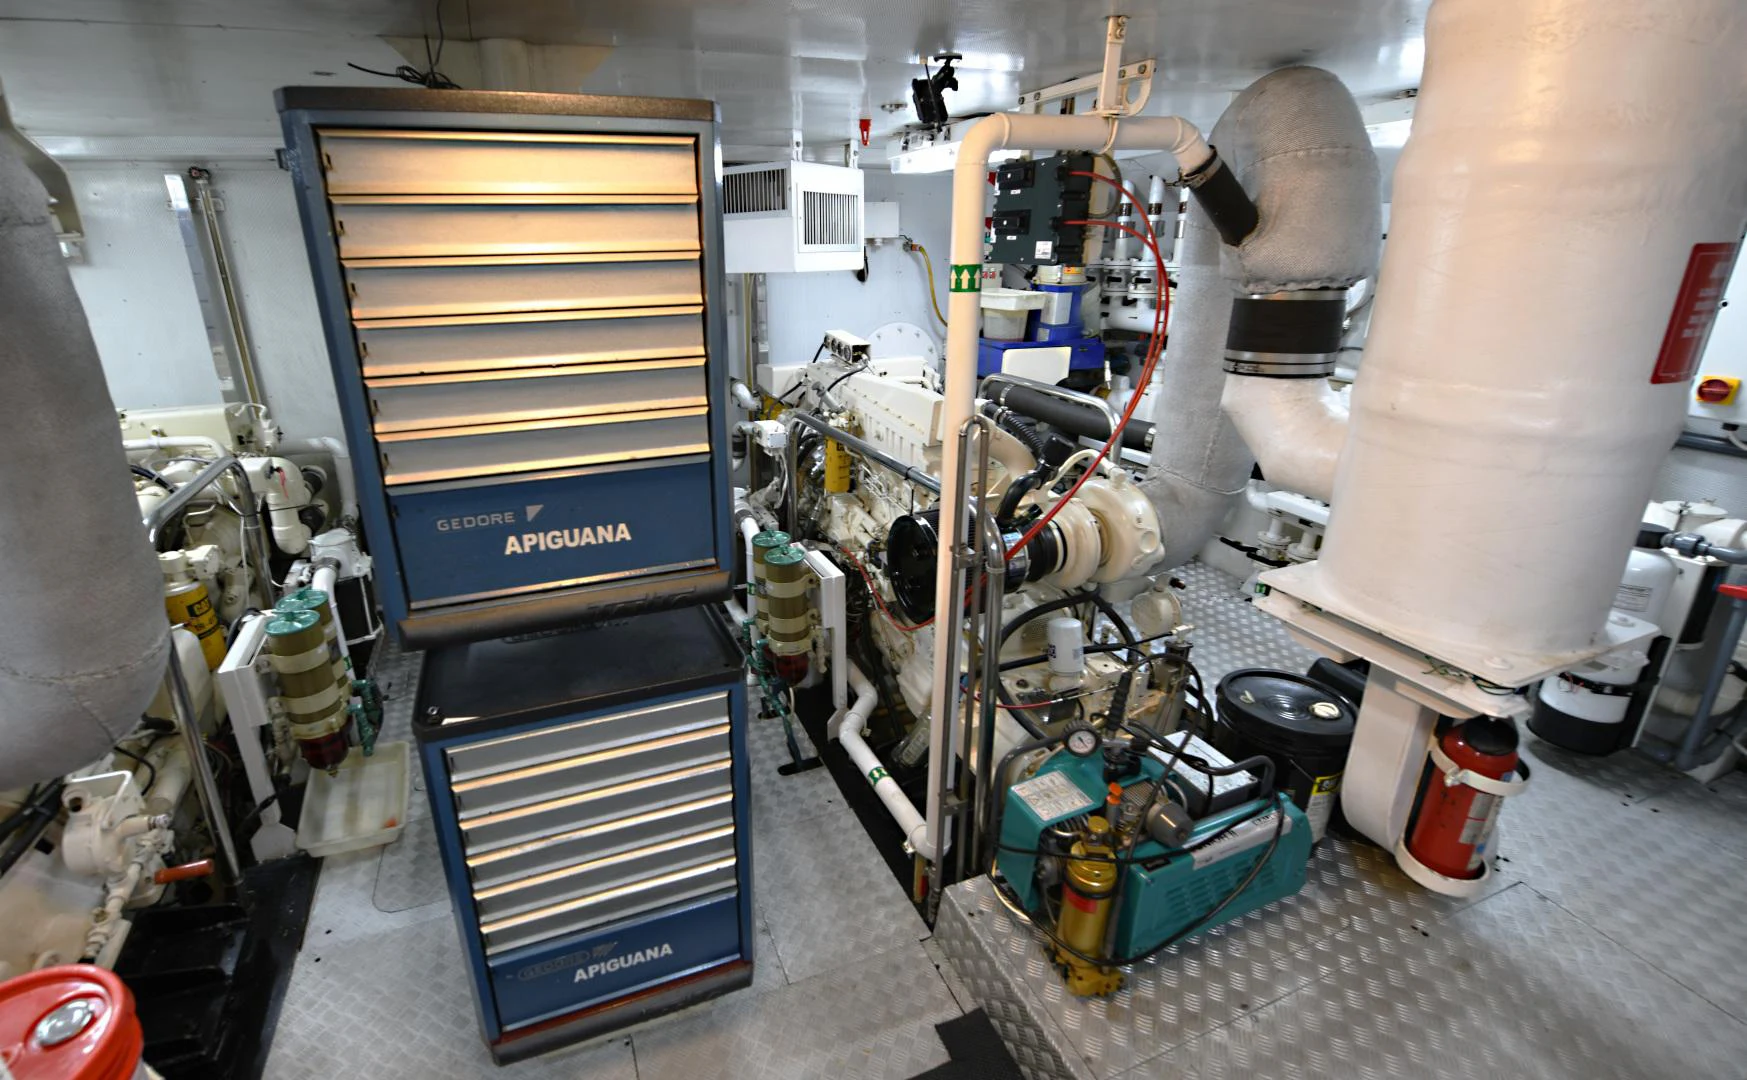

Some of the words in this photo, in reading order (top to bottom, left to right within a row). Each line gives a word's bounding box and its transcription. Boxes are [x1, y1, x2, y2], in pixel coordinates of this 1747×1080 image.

[436, 511, 516, 532] GEDORE
[504, 522, 632, 555] APIGUANA
[574, 943, 673, 983] APIGUANA
